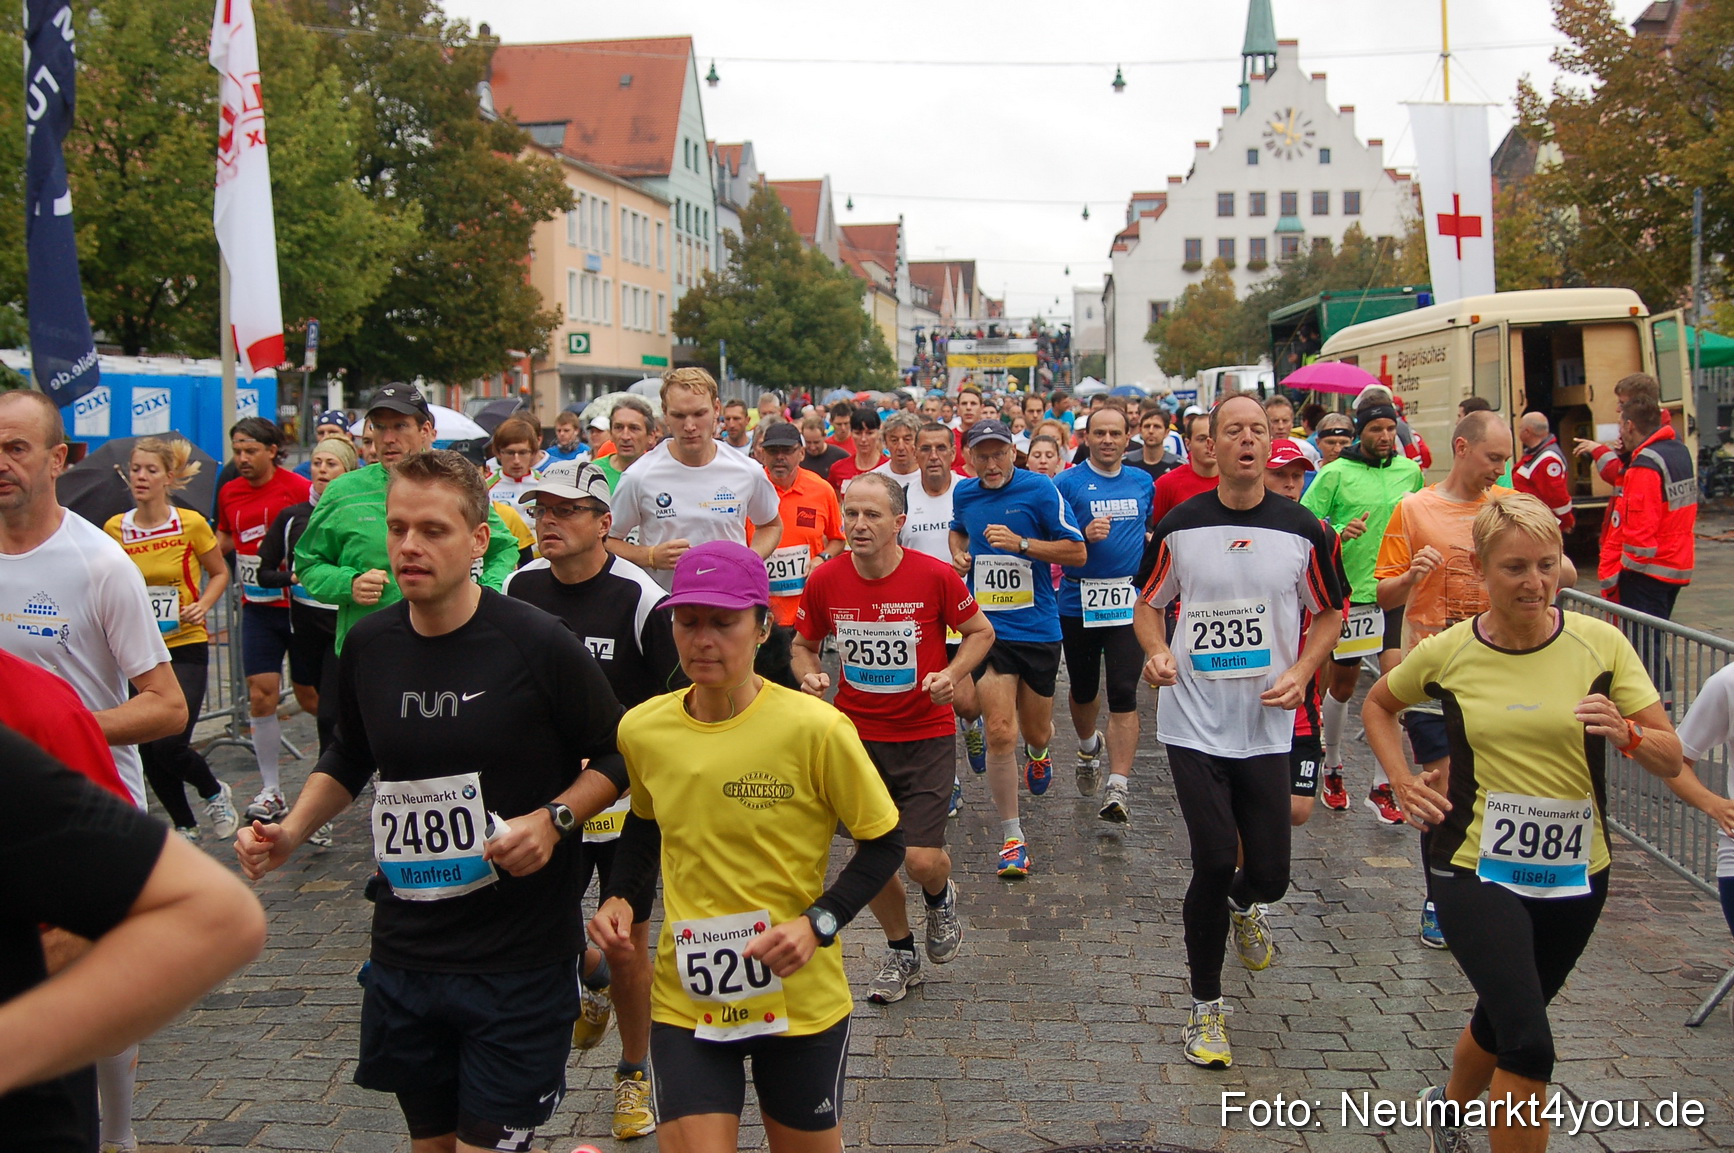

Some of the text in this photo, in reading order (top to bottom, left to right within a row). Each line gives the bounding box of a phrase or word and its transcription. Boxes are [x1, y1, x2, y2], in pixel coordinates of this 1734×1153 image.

[571, 334, 588, 352] D
[1397, 347, 1447, 371] Bayerisches
[1404, 400, 1419, 415] euz
[1091, 498, 1138, 512] HUBER
[125, 539, 185, 555] MAX BÖGL
[241, 565, 256, 584] 22
[766, 557, 806, 579] 2917
[985, 569, 1021, 589] 406
[992, 594, 1014, 603] Franz
[1087, 587, 1131, 607] 2767
[151, 599, 173, 618] 87
[1187, 607, 1253, 618] PARTL Neumarkt
[838, 627, 862, 636] PARTL
[1192, 617, 1264, 651] 2335
[844, 639, 909, 666] 2533
[1211, 656, 1247, 669] Martin
[859, 671, 896, 683] Werner
[401, 691, 458, 718] run
[1300, 760, 1315, 777] 18
[376, 790, 458, 805] ARTL Neumarkt
[731, 783, 786, 797] FRANCESCO
[1487, 800, 1580, 819] PARTL Neumarkt
[381, 806, 475, 855] 2480
[583, 816, 615, 831] chael
[1491, 818, 1583, 860] 2984
[400, 864, 462, 884] Manfred
[1512, 869, 1557, 885] gisela
[702, 924, 763, 943] Neumark
[687, 947, 772, 997] 520
[721, 1006, 749, 1023] Ute
